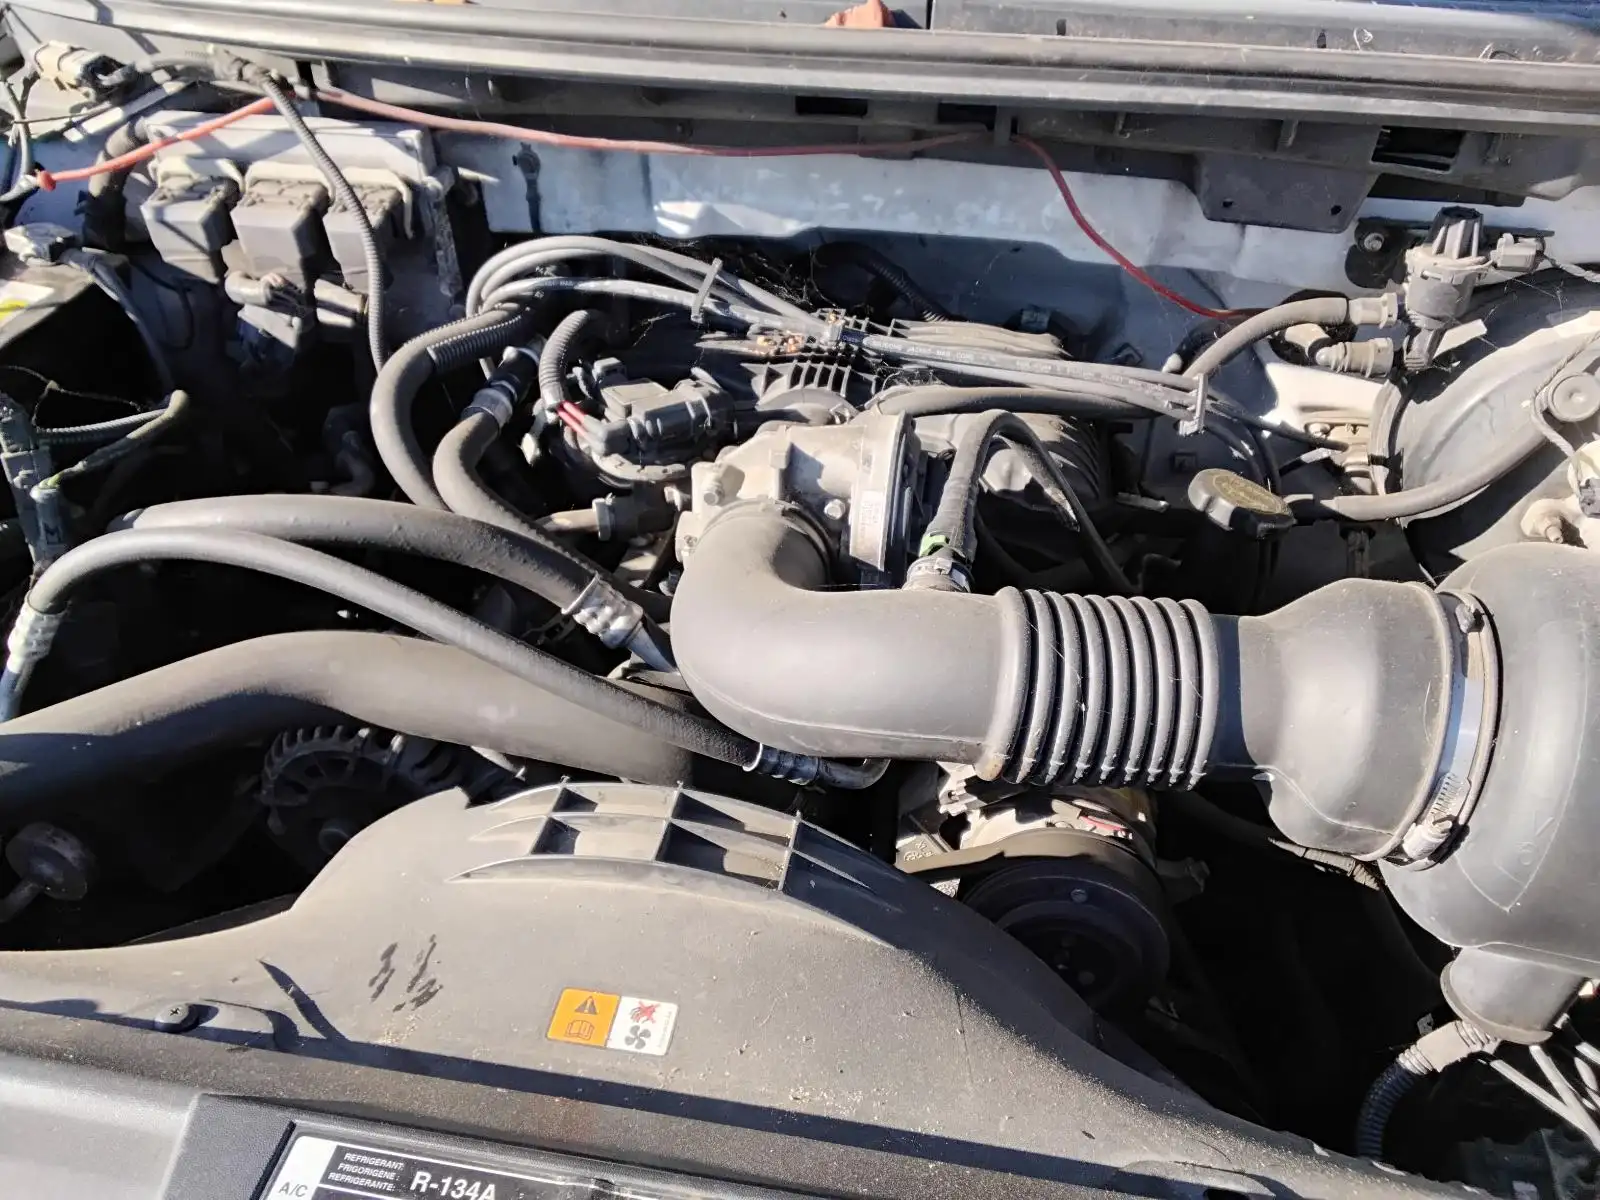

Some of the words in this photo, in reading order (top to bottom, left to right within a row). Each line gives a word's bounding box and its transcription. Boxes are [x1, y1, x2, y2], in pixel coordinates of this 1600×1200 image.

[344, 1152, 405, 1171] REFRIGERANT:
[278, 1181, 308, 1198] A/C
[327, 1172, 396, 1192] REFRIGERANTE:
[409, 1170, 496, 1200] R-134A
